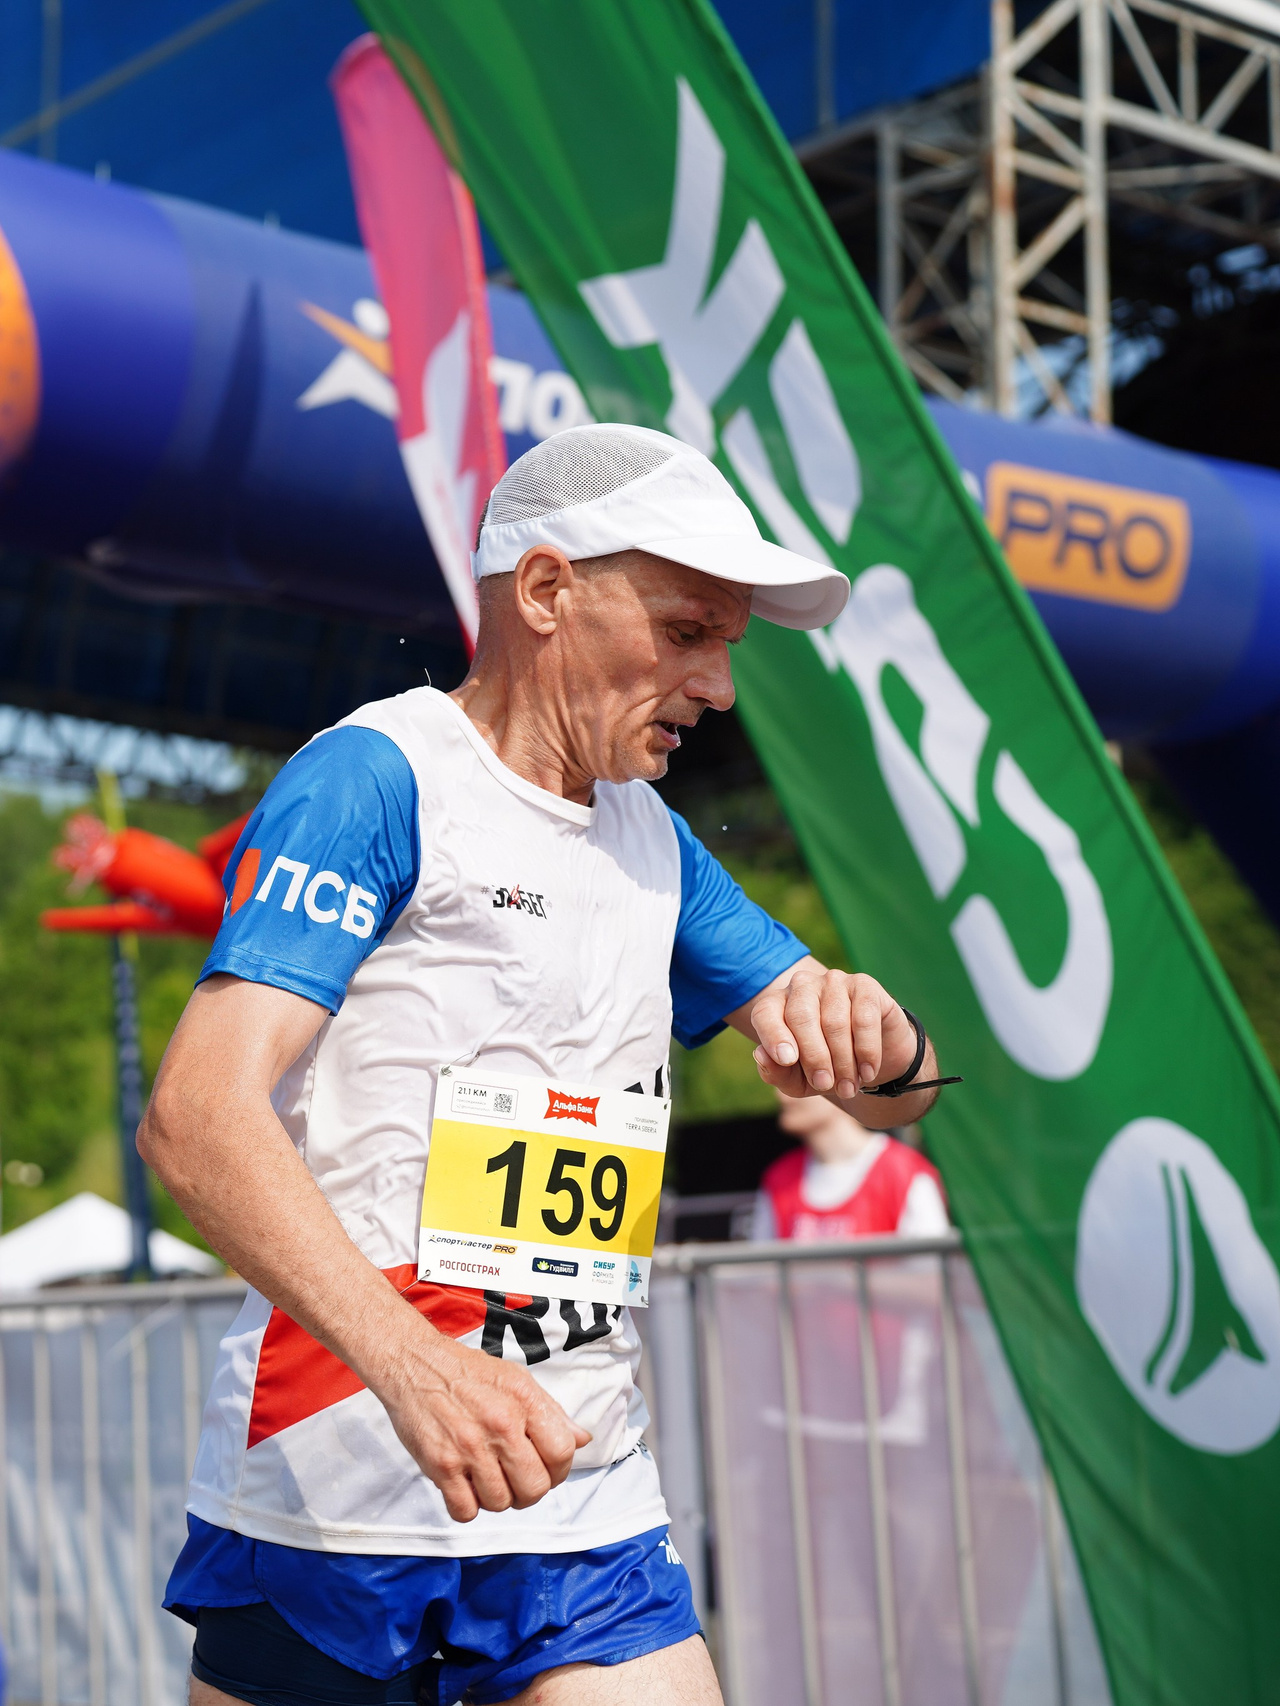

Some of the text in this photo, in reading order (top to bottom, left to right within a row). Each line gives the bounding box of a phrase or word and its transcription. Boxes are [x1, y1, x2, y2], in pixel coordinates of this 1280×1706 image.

[1000, 488, 1175, 581] PRO
[255, 855, 377, 939] ПСБ
[552, 1099, 594, 1114] Альфа Банк
[486, 1140, 628, 1242] 159
[493, 1244, 516, 1254] PRO
[439, 1259, 501, 1276] РОСГОССТРАХ
[593, 1260, 616, 1270] СИБУР
